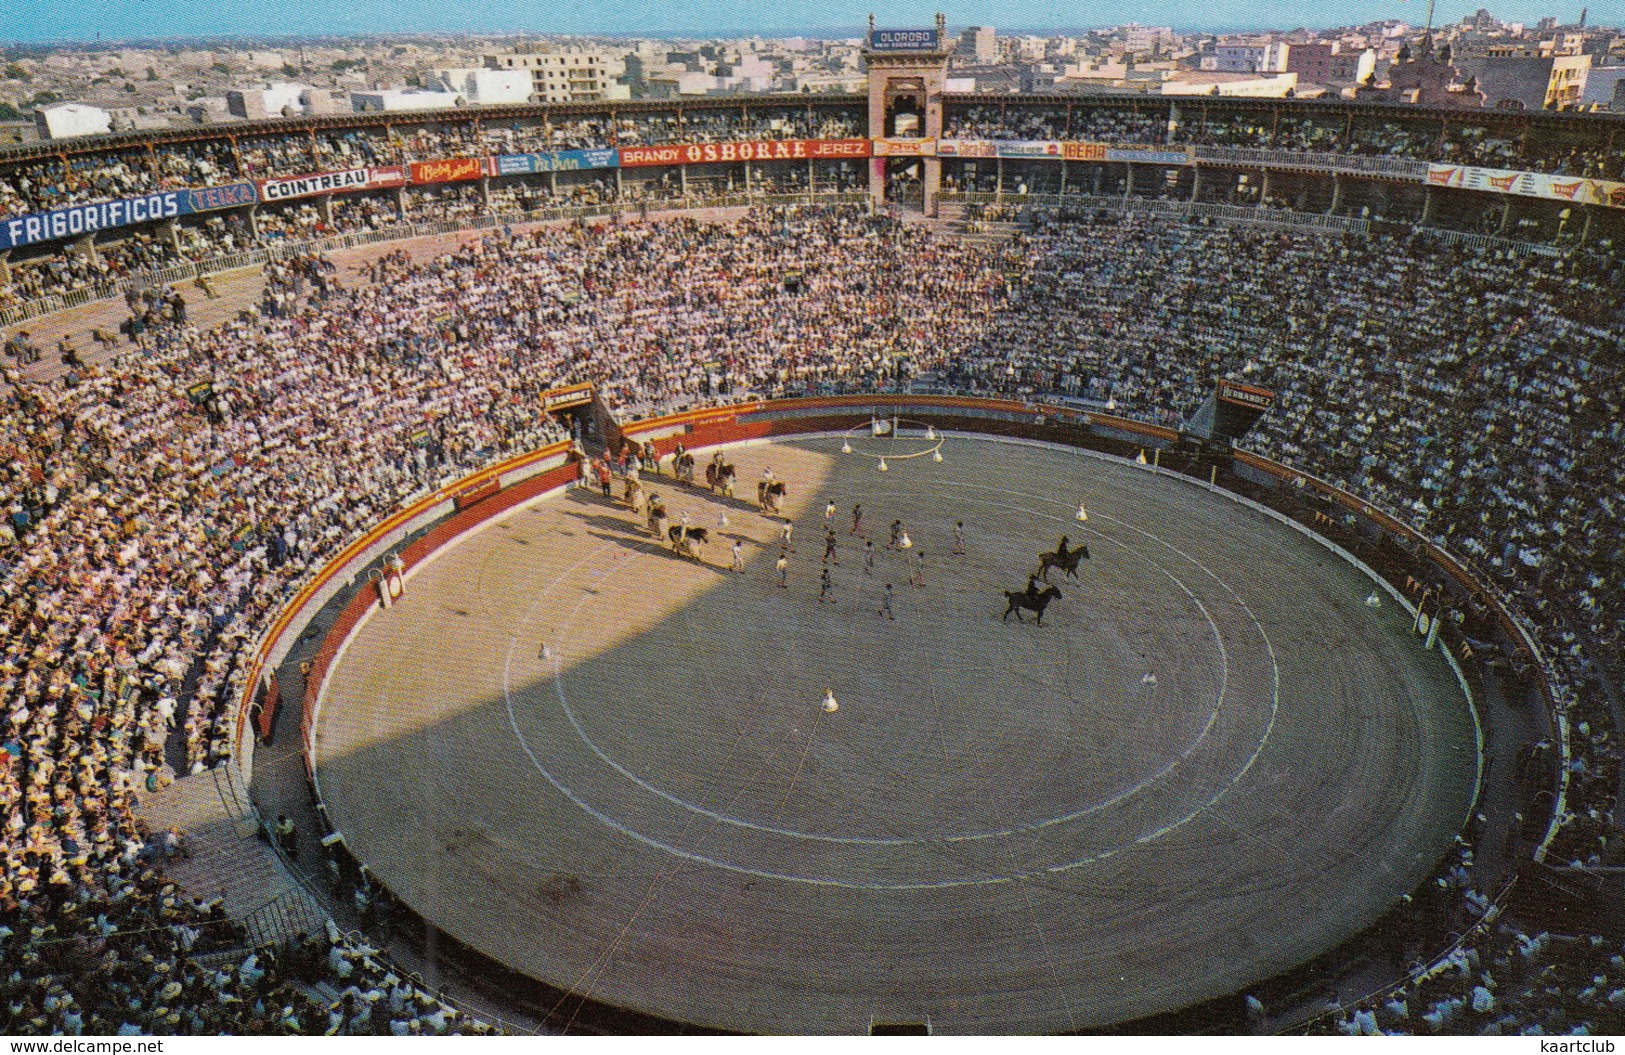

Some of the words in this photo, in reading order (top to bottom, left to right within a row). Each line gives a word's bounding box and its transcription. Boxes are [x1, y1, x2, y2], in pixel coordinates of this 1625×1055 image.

[880, 32, 931, 42] OLOROSO
[623, 149, 679, 162] BRANDY
[687, 141, 806, 162] OSBORNE
[813, 143, 865, 155] JEREZ
[1063, 141, 1106, 158] IBERIA
[267, 170, 366, 198] COINTREAU
[8, 193, 179, 246] FRIGORIFICOS
[193, 184, 251, 209] TEIKA
